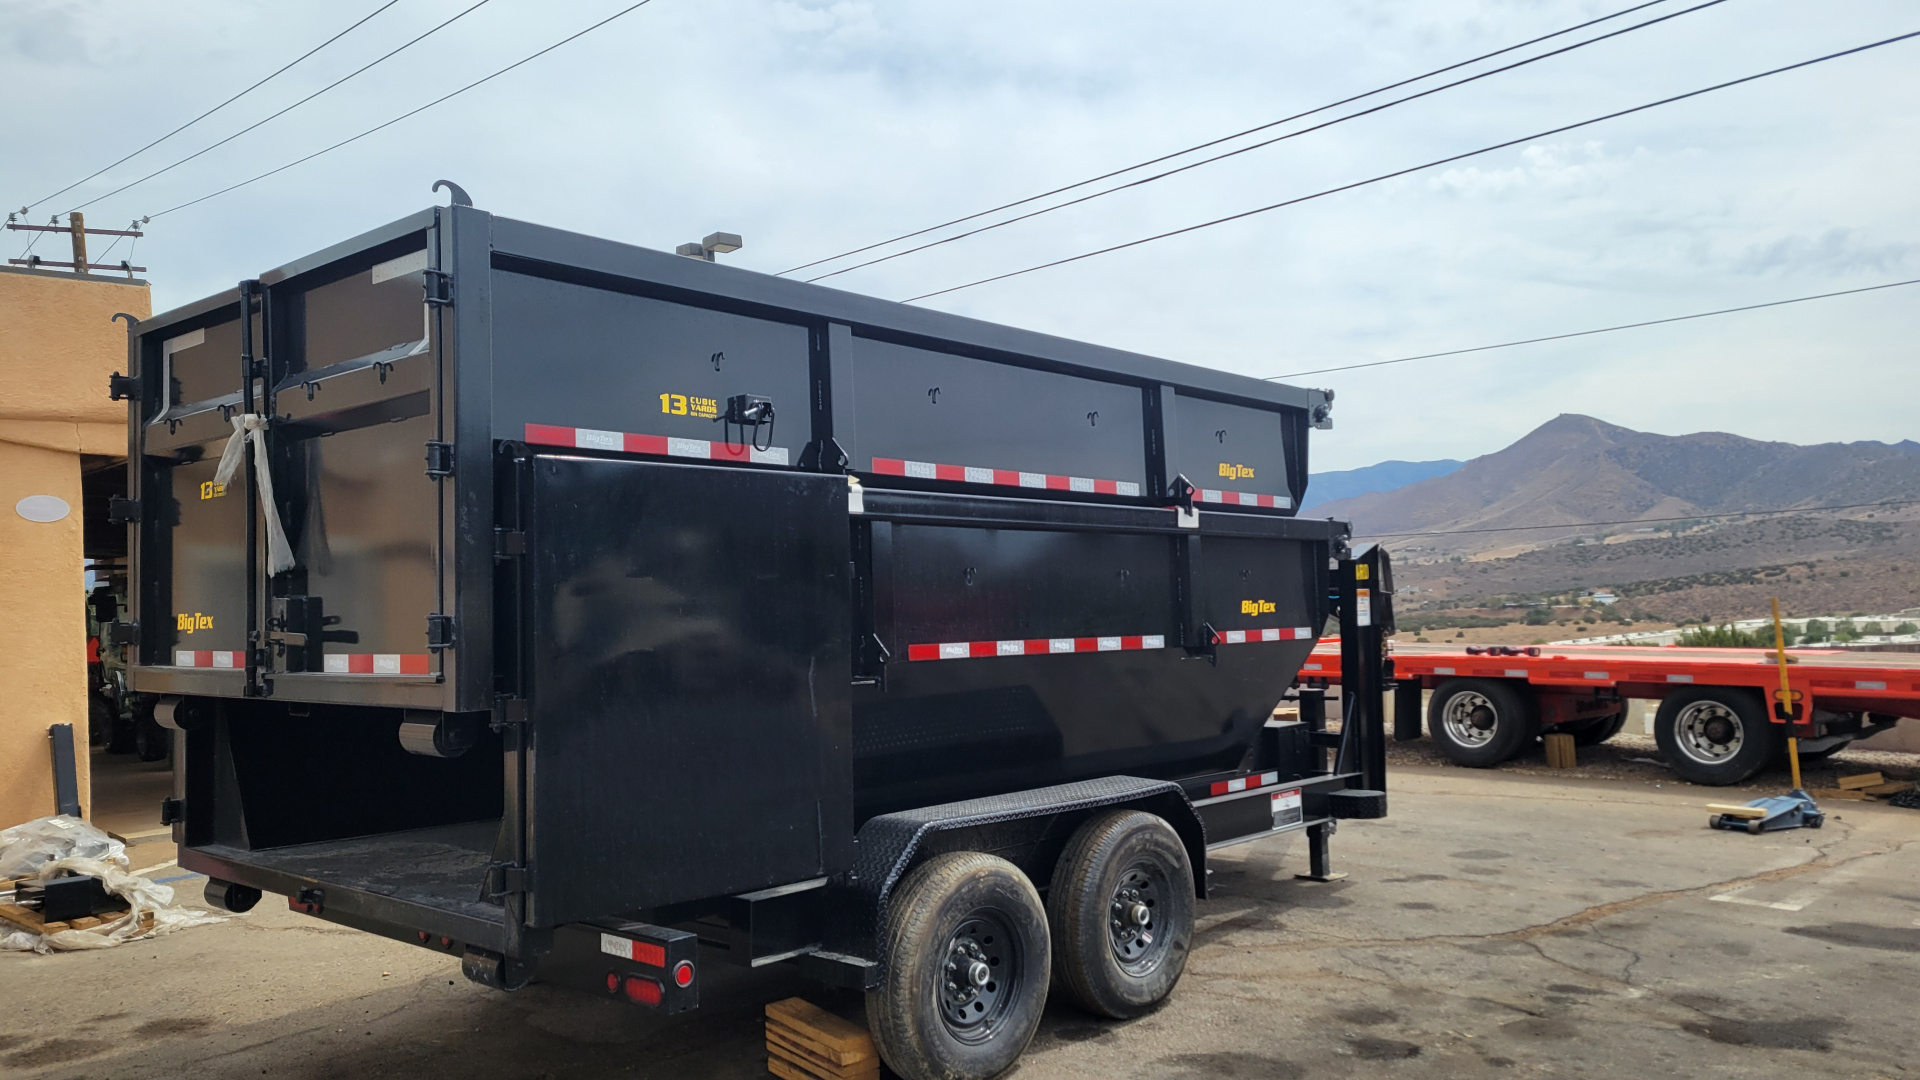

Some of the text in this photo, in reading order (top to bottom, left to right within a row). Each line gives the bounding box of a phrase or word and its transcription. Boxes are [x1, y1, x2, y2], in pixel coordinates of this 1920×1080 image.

[660, 393, 687, 416] 13
[690, 396, 717, 407] CUBIC
[690, 403, 717, 414] YARDS
[1218, 463, 1255, 480] BigTex
[200, 481, 213, 500] 13
[1241, 600, 1276, 616] BigTex
[177, 612, 214, 634] BigTex
